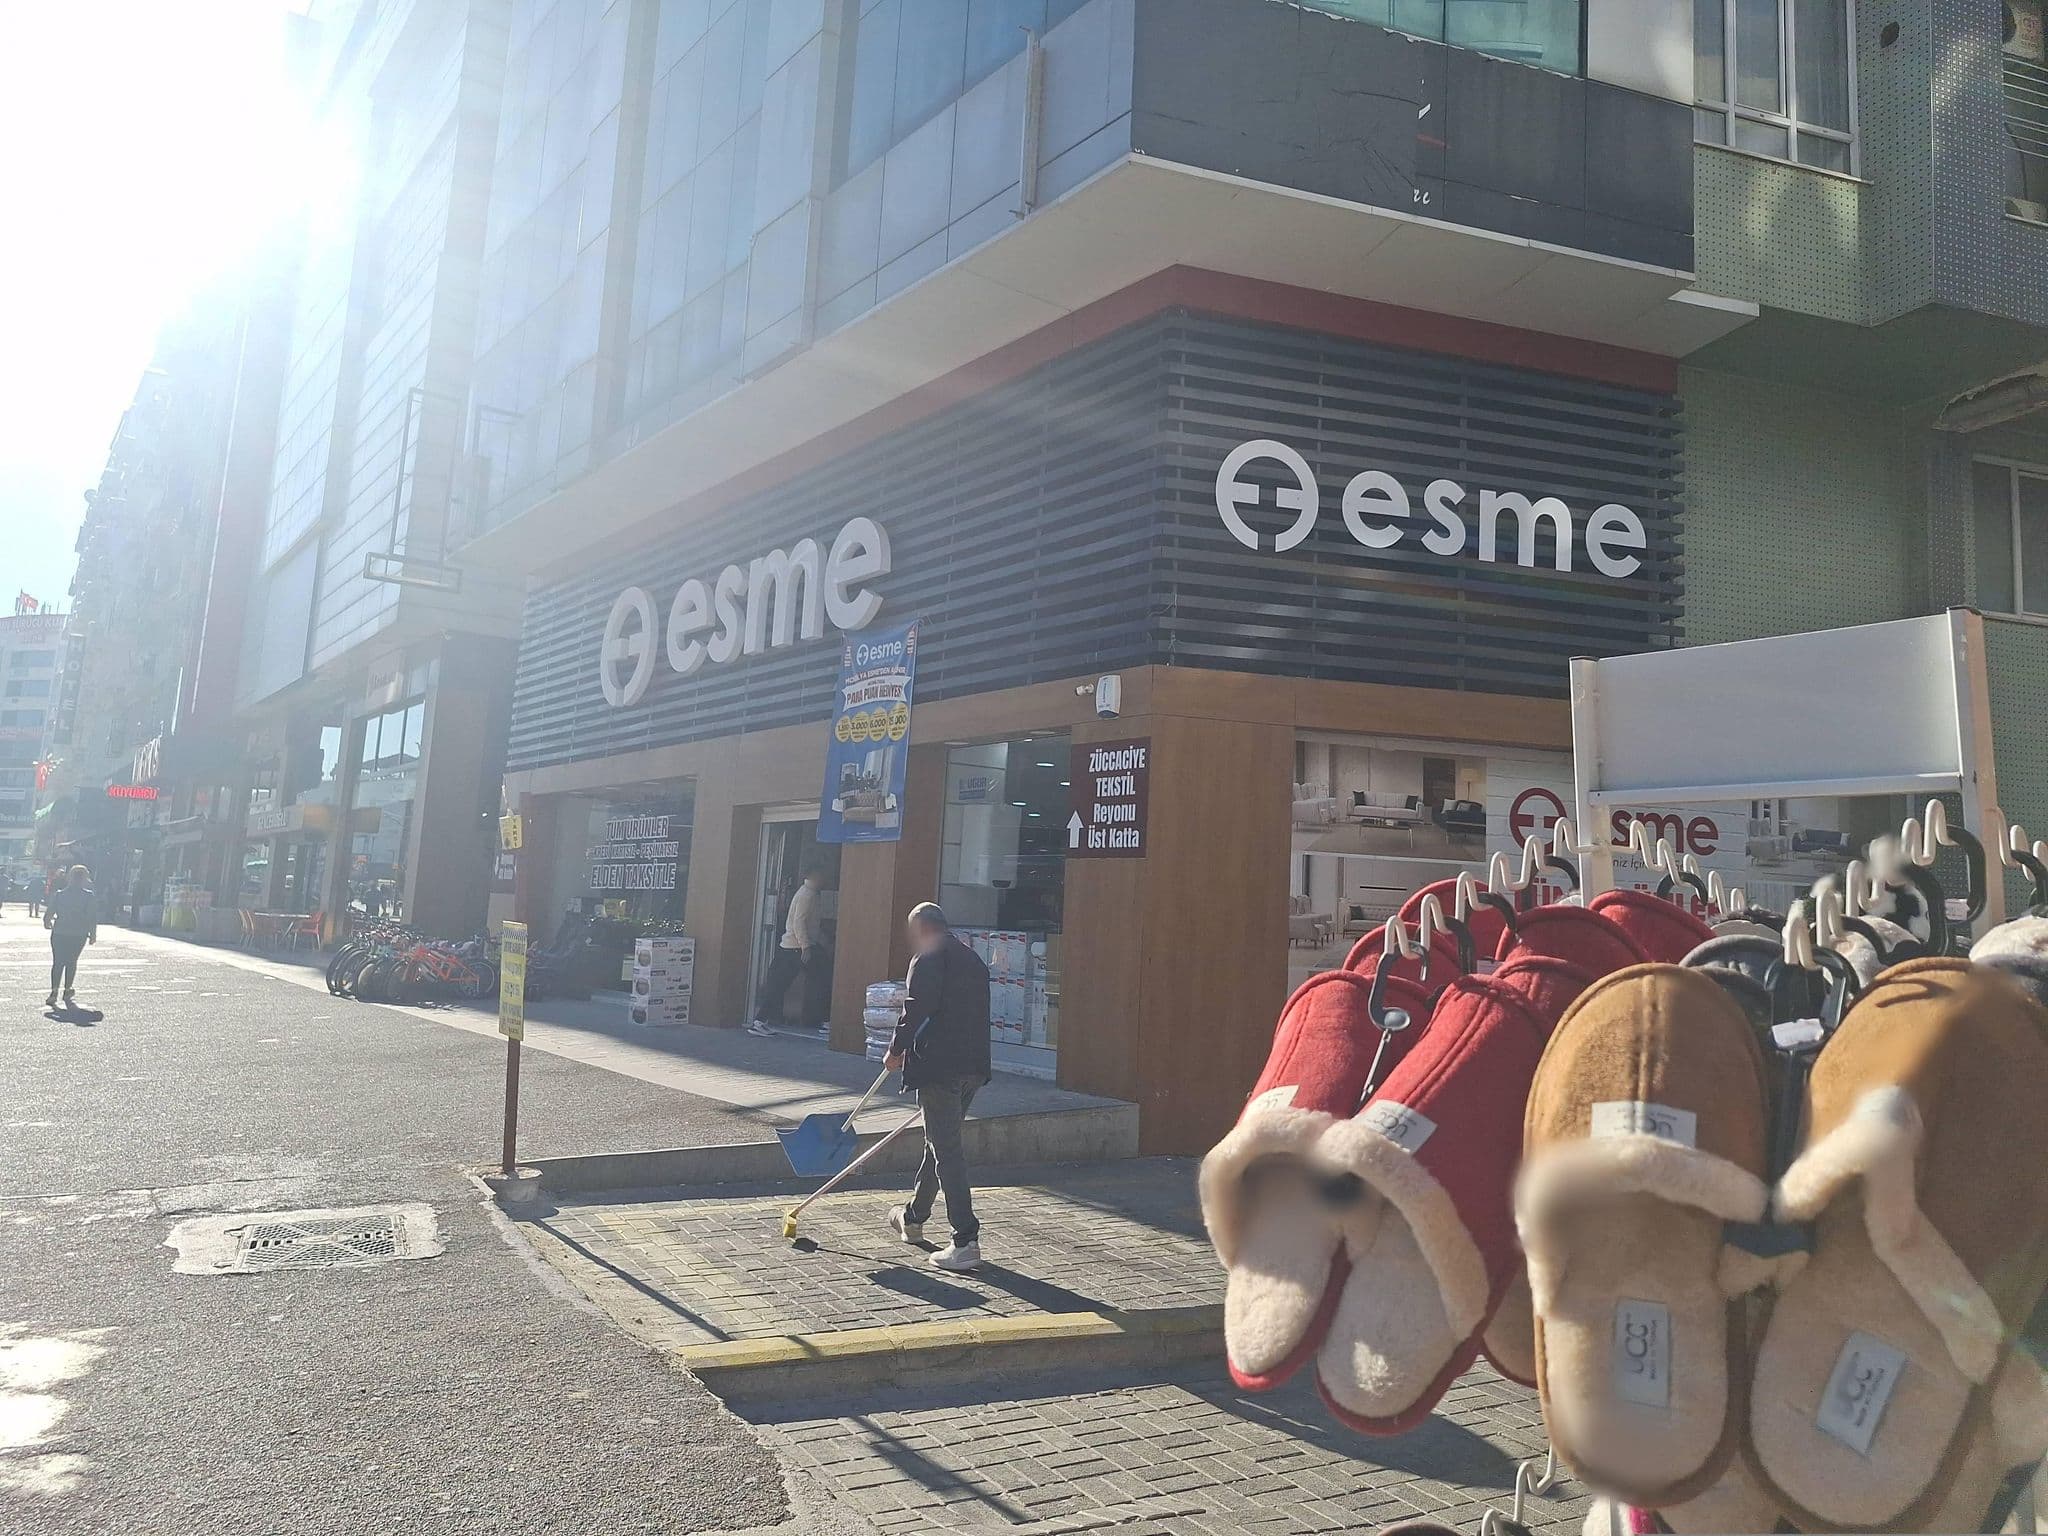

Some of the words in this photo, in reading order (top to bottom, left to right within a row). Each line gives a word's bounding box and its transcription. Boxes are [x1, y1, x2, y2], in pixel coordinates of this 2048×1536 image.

[1342, 470, 1647, 578] esme
[667, 517, 891, 672] esme
[870, 641, 902, 660] esme
[1089, 745, 1146, 772] ZÜCCACİYE
[1096, 771, 1136, 797] TEKSTİL
[1094, 803, 1136, 824] Reyonu
[1088, 824, 1106, 848] Üst
[1108, 827, 1140, 848] Katta
[1611, 809, 1719, 856] sme
[591, 863, 624, 889] ELDEN
